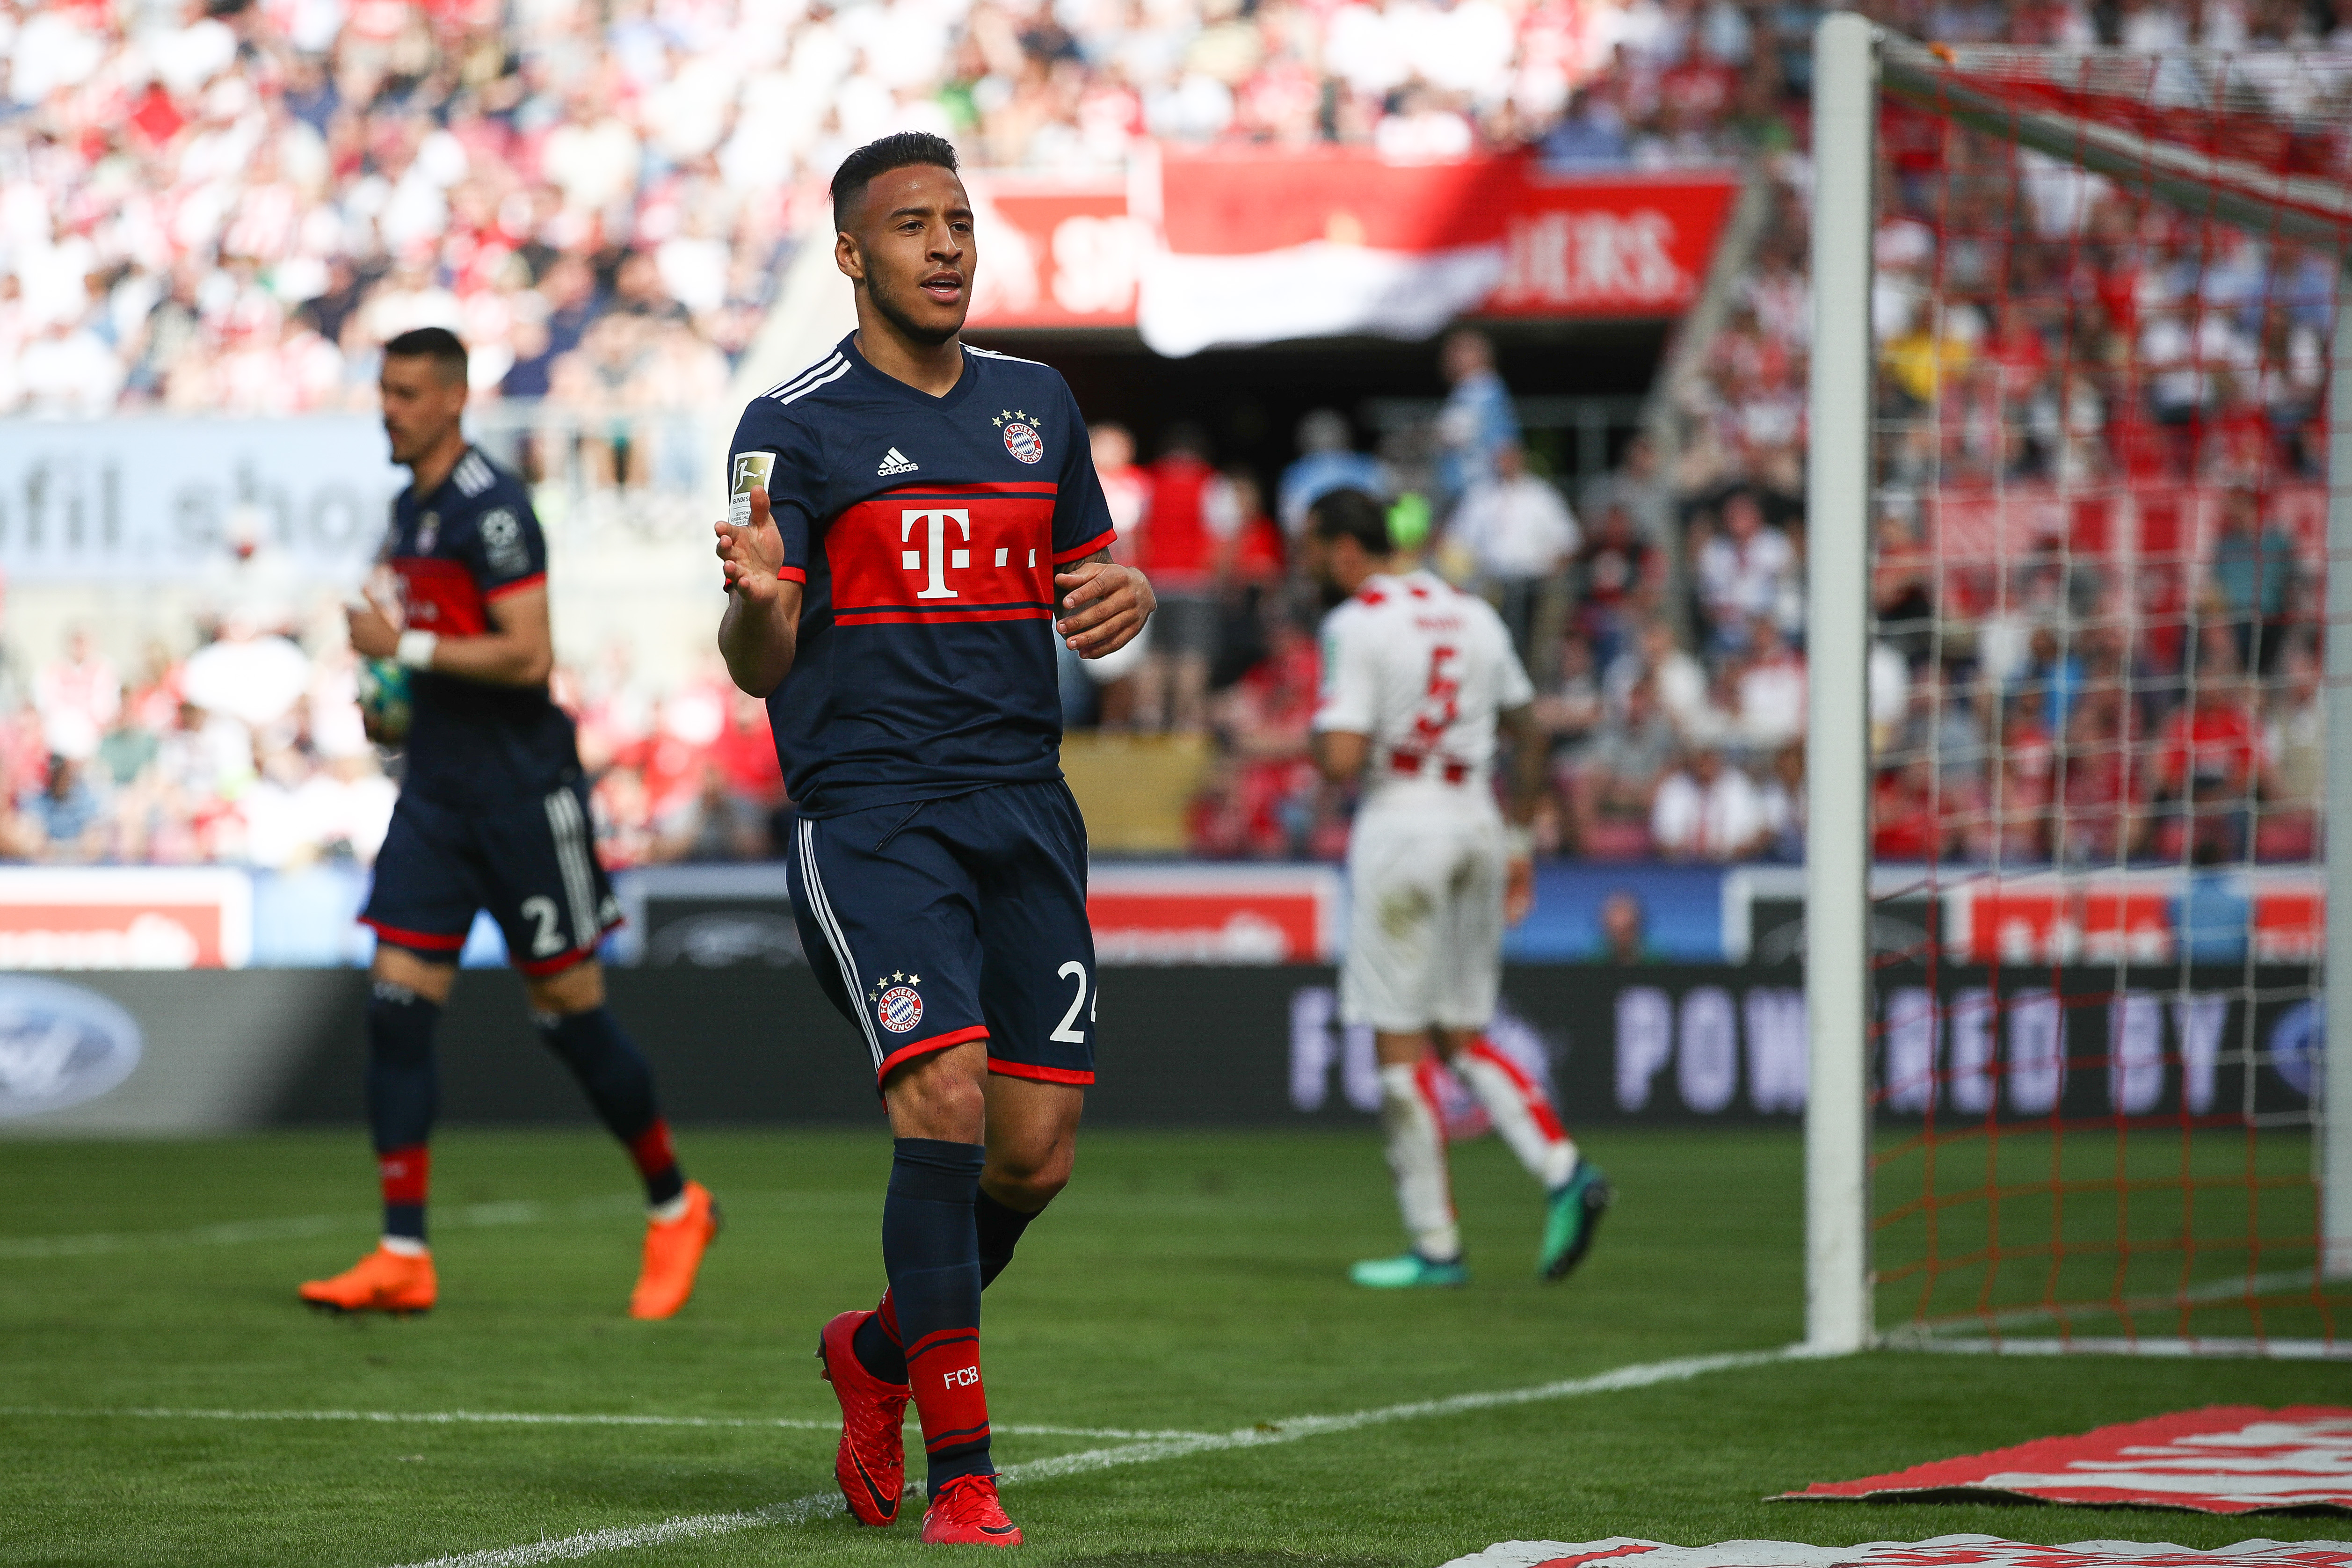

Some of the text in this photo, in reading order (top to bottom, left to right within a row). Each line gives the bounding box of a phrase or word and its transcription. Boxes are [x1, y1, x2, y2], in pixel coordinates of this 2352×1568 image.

[1006, 425, 1038, 442] FC BAYERN
[877, 463, 919, 476] adidas
[1415, 643, 1460, 746] 5
[521, 895, 567, 958] 2
[880, 989, 917, 1013] FC BAYERN
[1613, 985, 2067, 1116] POWRED
[2106, 987, 2229, 1116] BY
[944, 1365, 979, 1390] FCB
